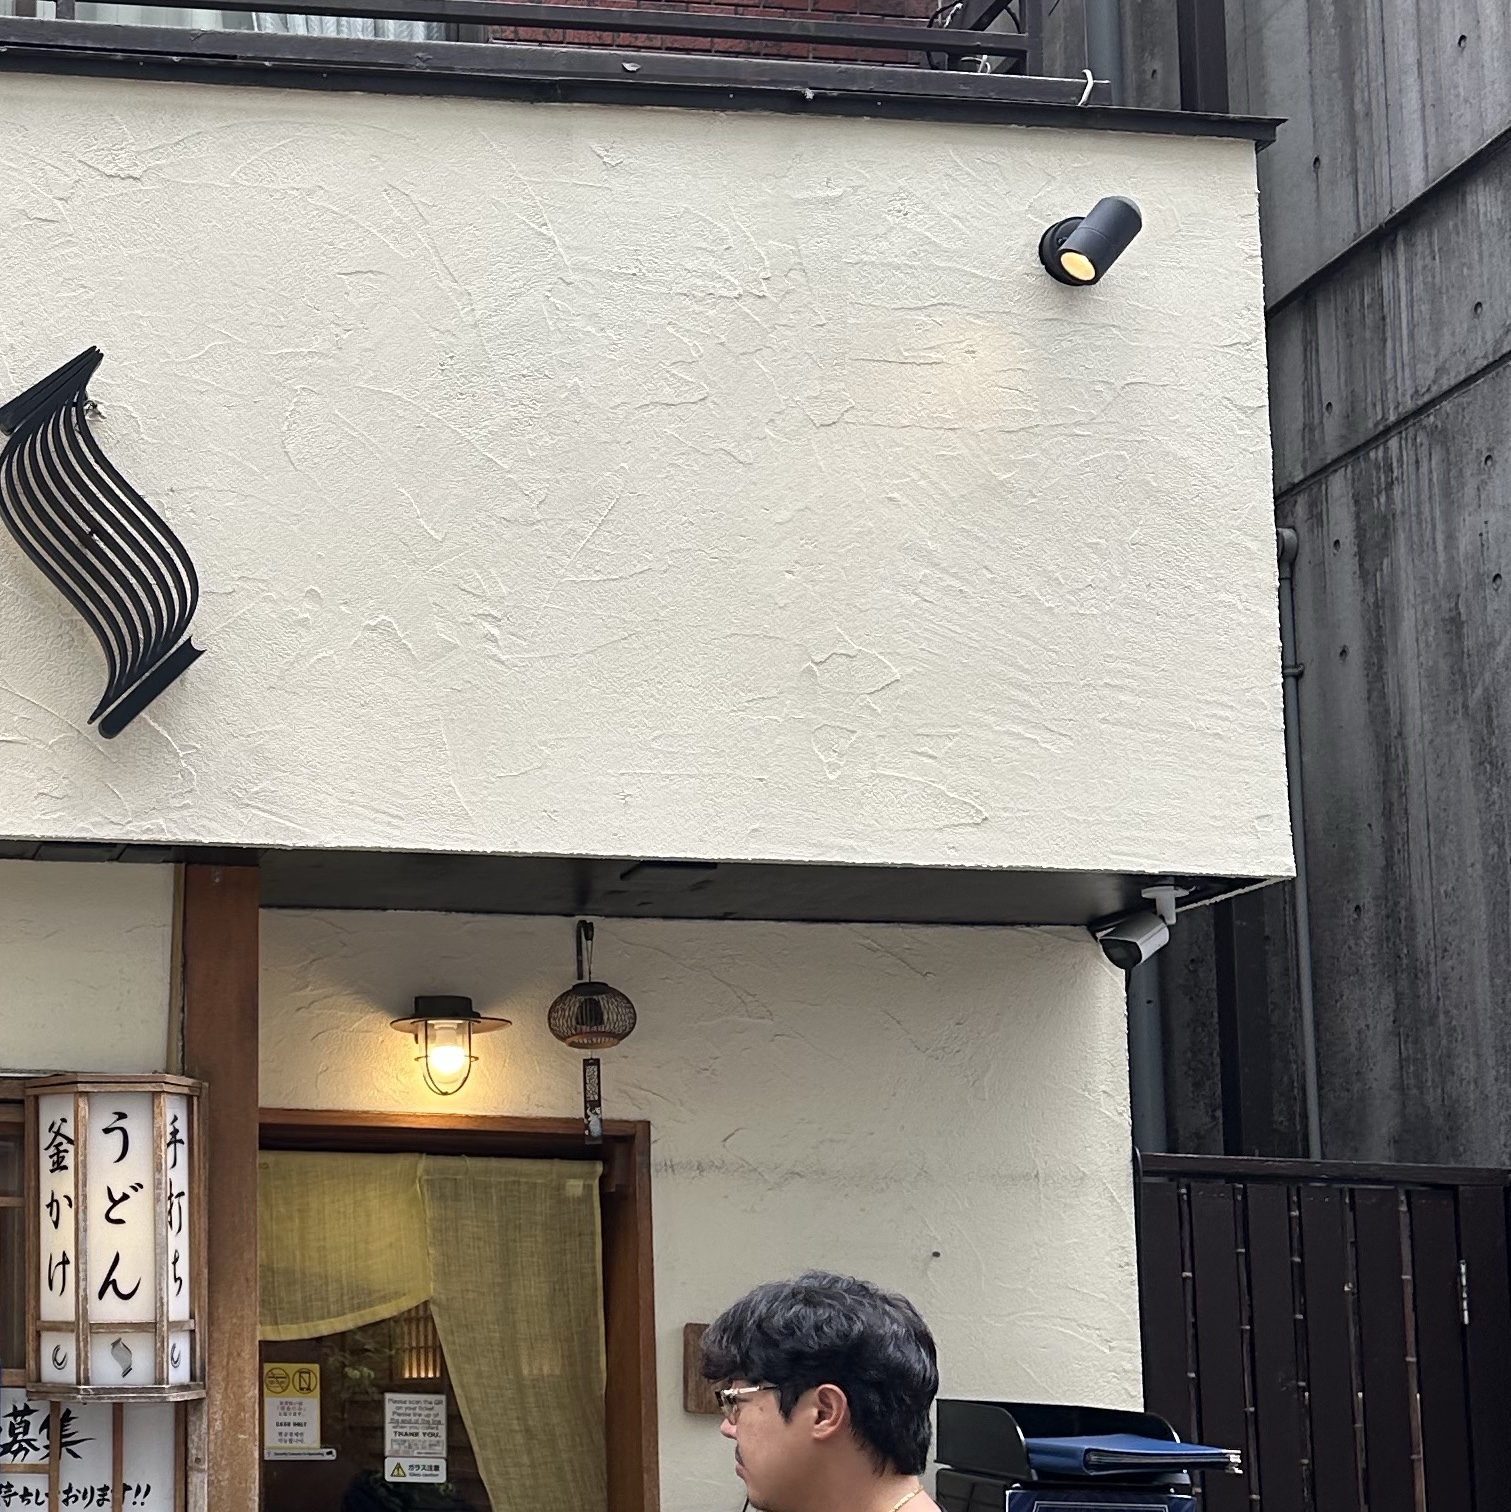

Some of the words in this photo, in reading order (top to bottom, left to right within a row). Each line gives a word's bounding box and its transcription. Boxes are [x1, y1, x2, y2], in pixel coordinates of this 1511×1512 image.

[43, 1116, 75, 1297] 釜かけ
[97, 1111, 143, 1301] うどん
[166, 1113, 186, 1297] 手打ち
[0, 1402, 96, 1463] 募集
[0, 1481, 151, 1509] 待ちしおります!!
